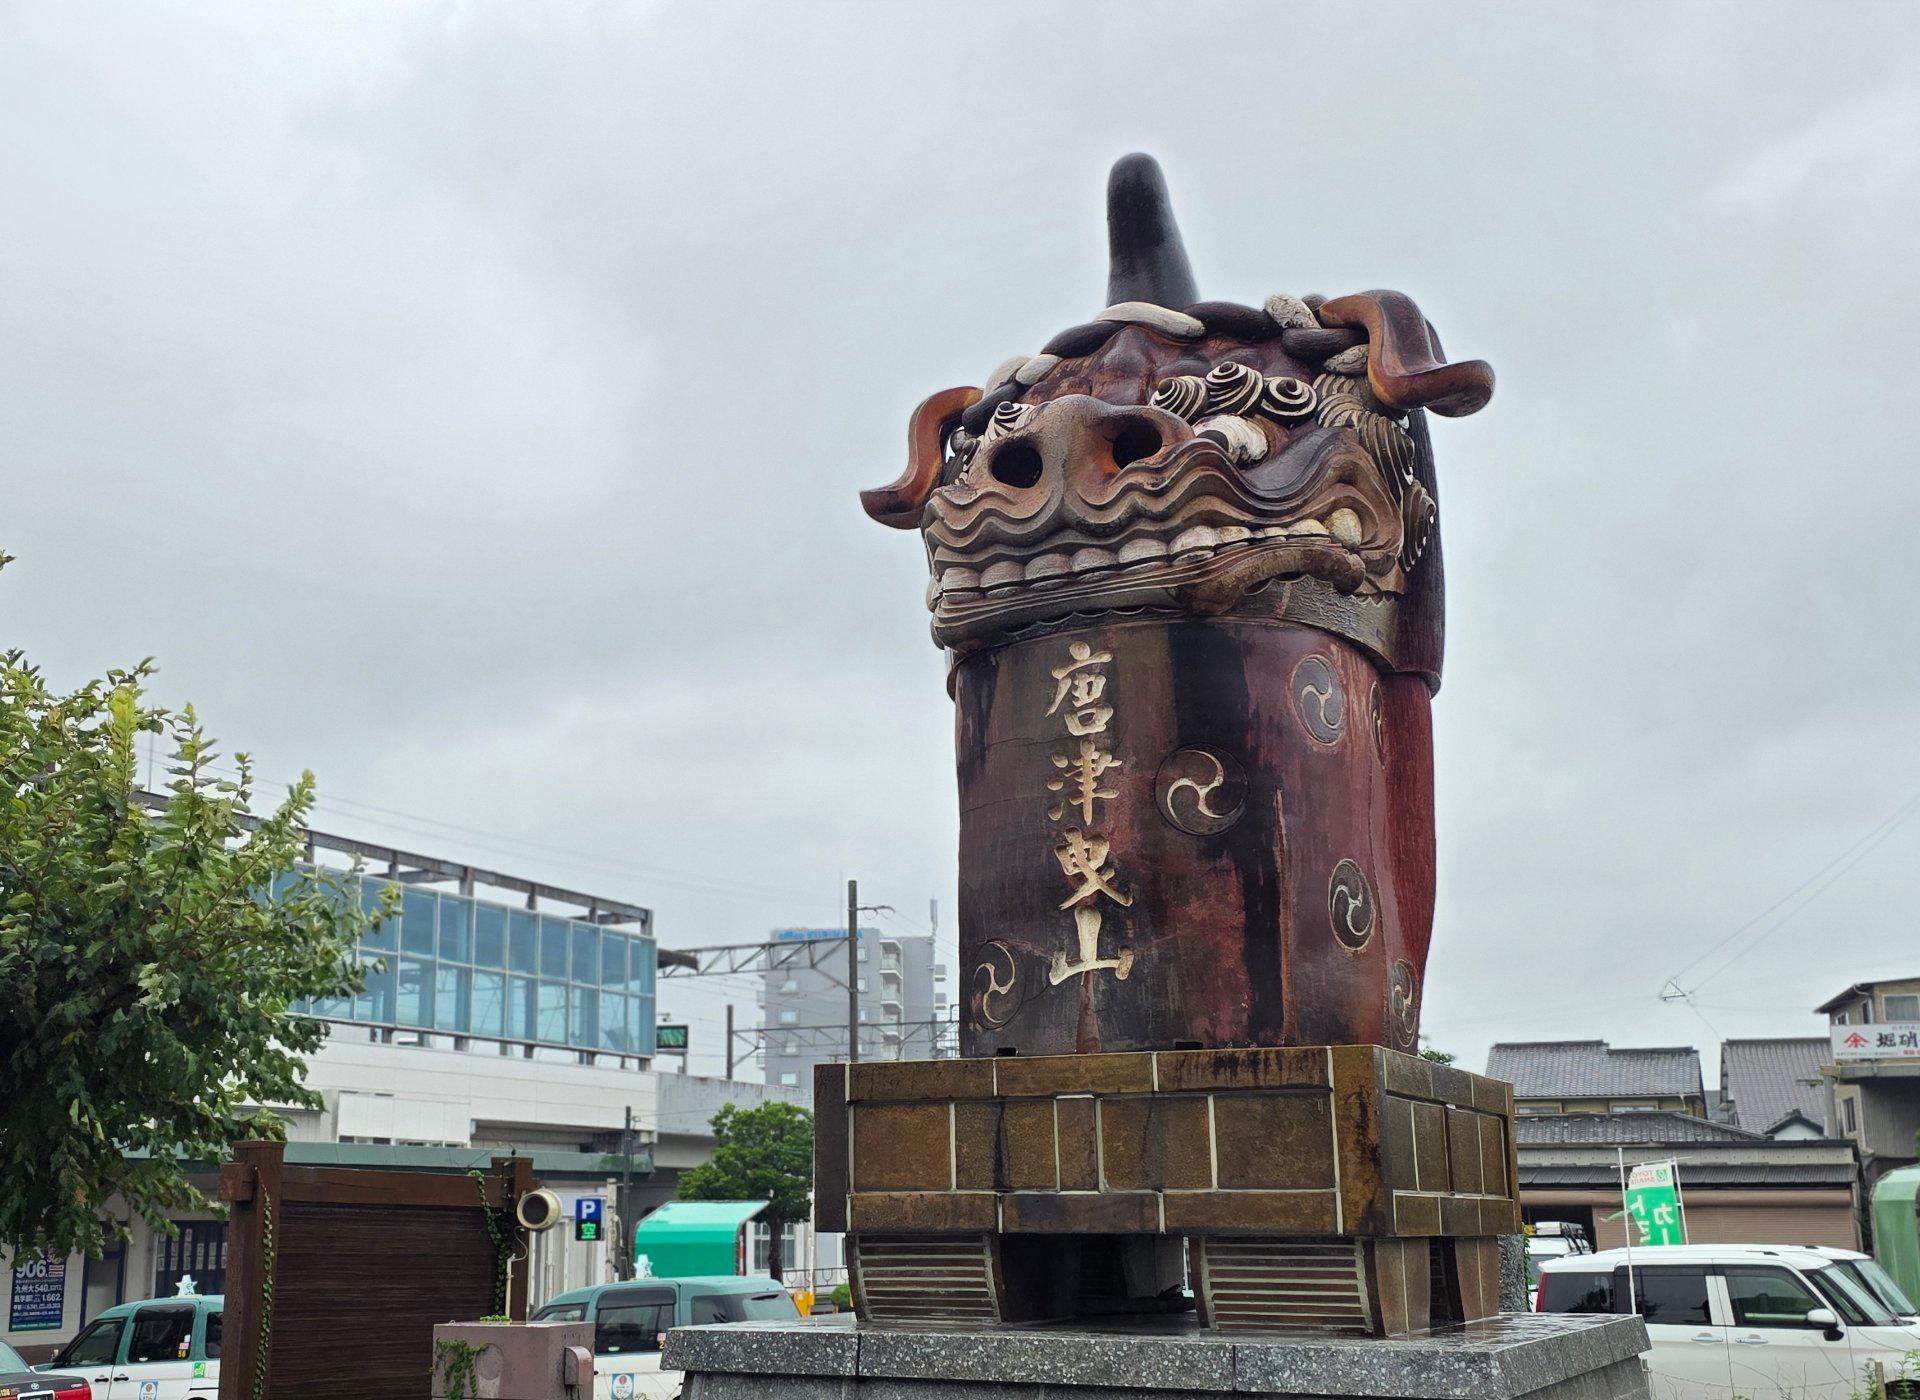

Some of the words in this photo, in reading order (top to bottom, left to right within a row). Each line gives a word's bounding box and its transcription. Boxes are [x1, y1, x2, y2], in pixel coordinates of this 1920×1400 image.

[1045, 640, 1133, 985] 唐津曳山
[1876, 1031, 1920, 1048] 堀硝
[582, 1200, 596, 1219] P
[581, 1222, 596, 1239] 空
